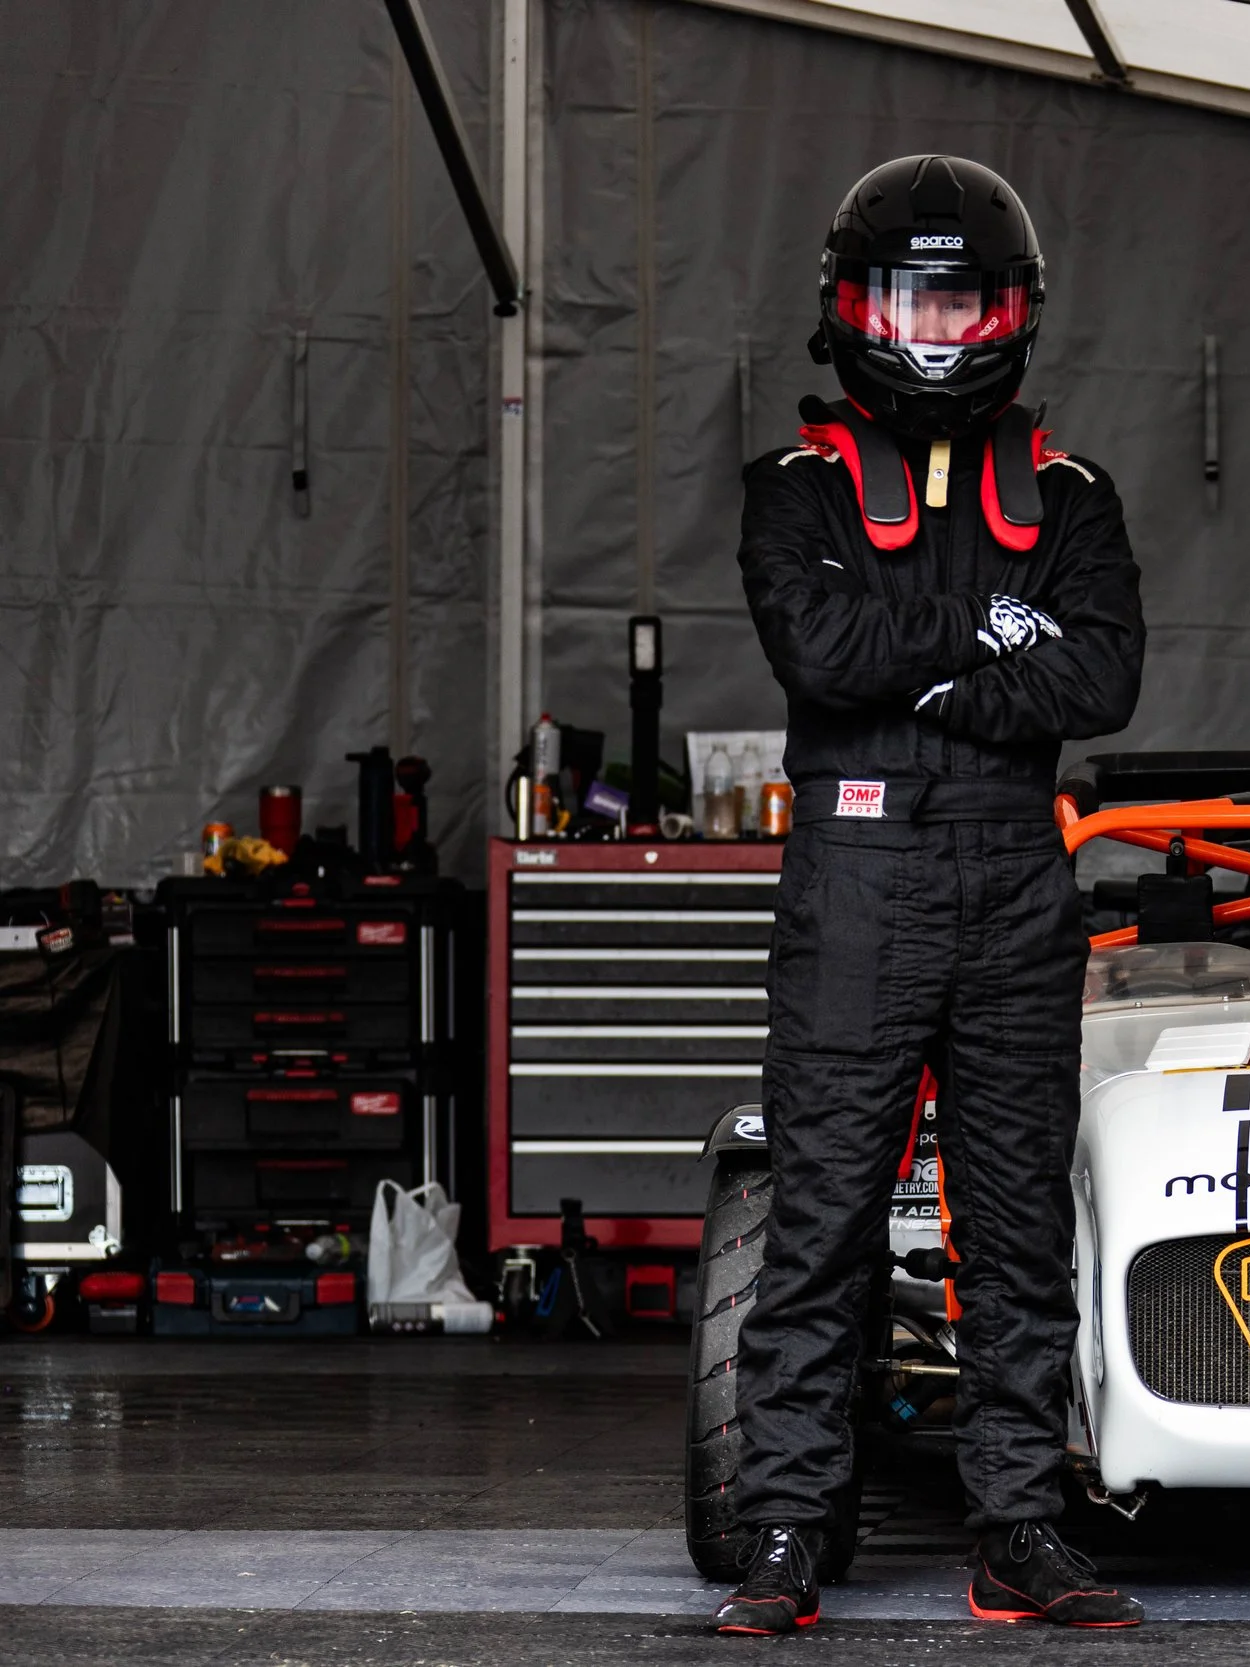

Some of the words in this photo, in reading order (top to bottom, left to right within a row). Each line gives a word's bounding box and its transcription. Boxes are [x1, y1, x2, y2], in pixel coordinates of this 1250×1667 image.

[911, 236, 963, 249] sparco
[843, 788, 880, 801] OMP
[841, 806, 878, 814] SPORT
